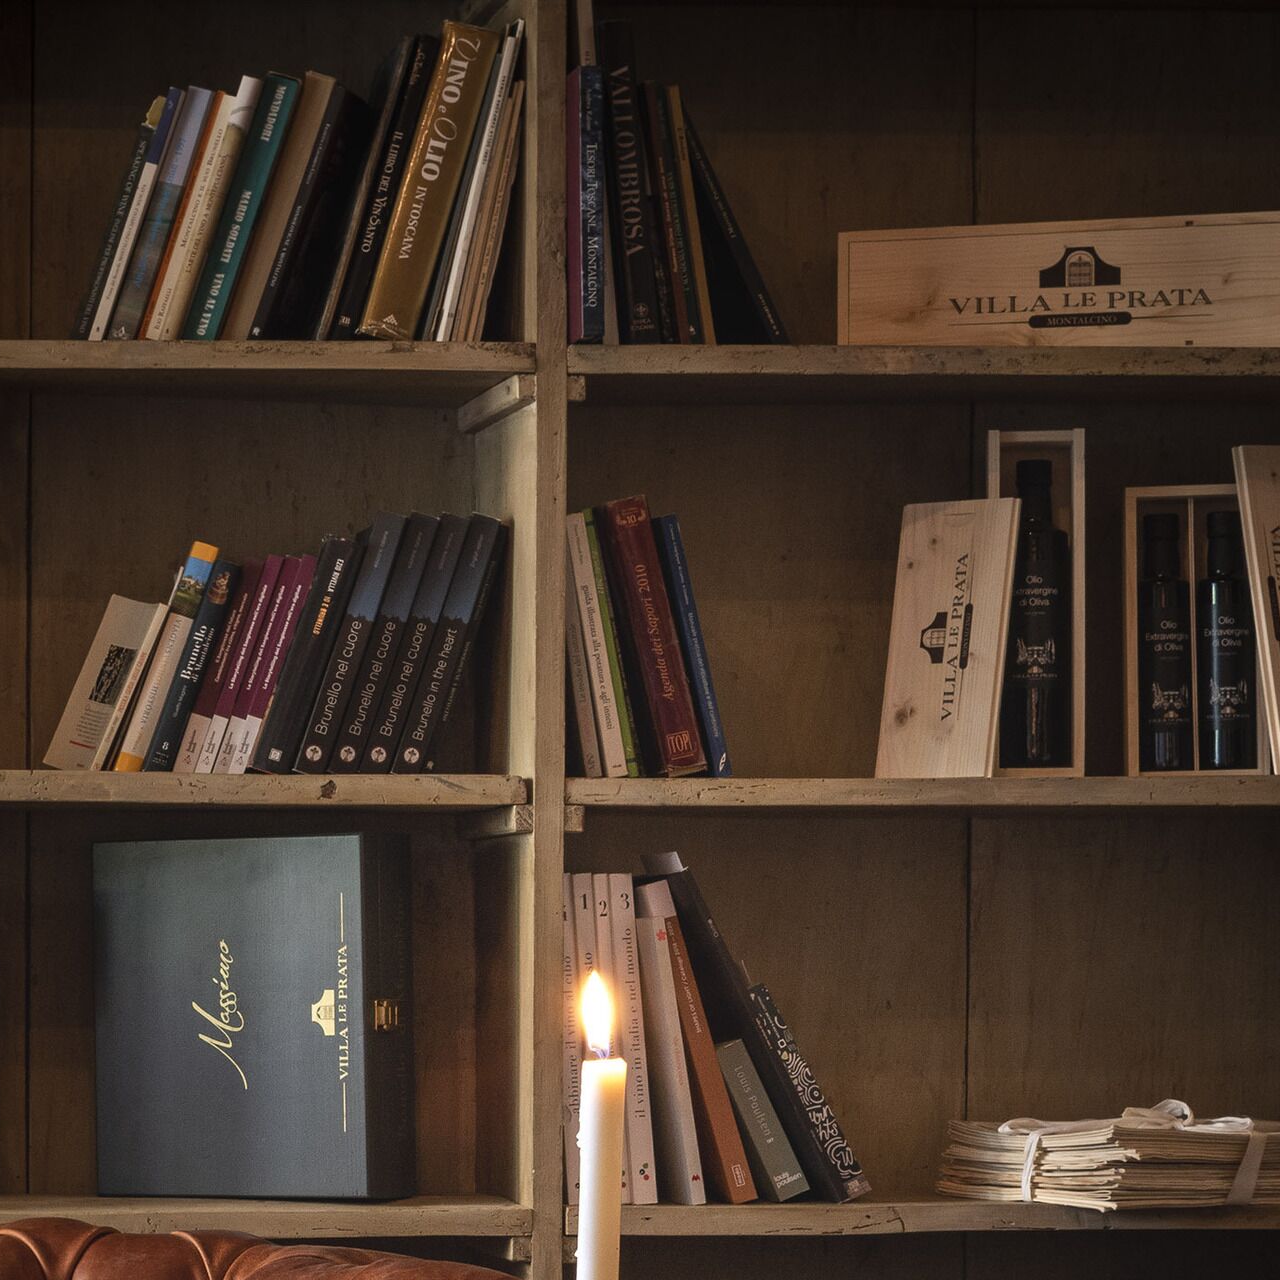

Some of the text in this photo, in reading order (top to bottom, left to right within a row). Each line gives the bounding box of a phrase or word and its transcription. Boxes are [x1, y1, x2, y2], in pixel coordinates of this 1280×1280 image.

[259, 82, 287, 143] MONDADORI
[377, 129, 403, 194] IL LIBRO DEL
[397, 32, 482, 261] VINO e OLIO IN TOSCANA
[585, 142, 598, 178] TESORI
[606, 64, 647, 257] VALLOMBROSA
[220, 188, 252, 264] MARIO SOLDATI
[585, 235, 598, 308] MONTALCINO
[195, 270, 225, 337] VINO AL VINO
[948, 287, 1213, 315] VILLA LE PRATA
[1046, 314, 1119, 327] MONTALCINO
[581, 583, 593, 605] guida
[1025, 575, 1043, 584] Olio
[586, 605, 599, 638] illustrata
[591, 637, 601, 652] alla
[631, 562, 677, 702] Agenda dei Sapori 2010
[941, 553, 969, 721] VILLA LE PRATA
[1160, 620, 1177, 629] Olio
[1218, 616, 1235, 625] Olio
[178, 622, 209, 680] Brunello
[190, 625, 216, 683] di Montalcino
[314, 619, 361, 736] Brunello nel cuore
[348, 620, 395, 737] Brunello nel cuore
[378, 620, 426, 738] Brunello nel cuore
[411, 625, 456, 742] Brunello in the heart
[667, 731, 692, 755] TOP
[581, 893, 588, 911] 1
[599, 900, 608, 917] 2
[620, 893, 630, 910] 3
[559, 954, 572, 985] cibo
[191, 938, 248, 1090] Massimo
[336, 945, 350, 1082] VILLA LE PRATA
[561, 1004, 576, 1036] vino
[620, 927, 646, 1118] il vino in italia e nel mondo
[564, 1040, 576, 1049] il
[565, 1053, 581, 1114] abbinare
